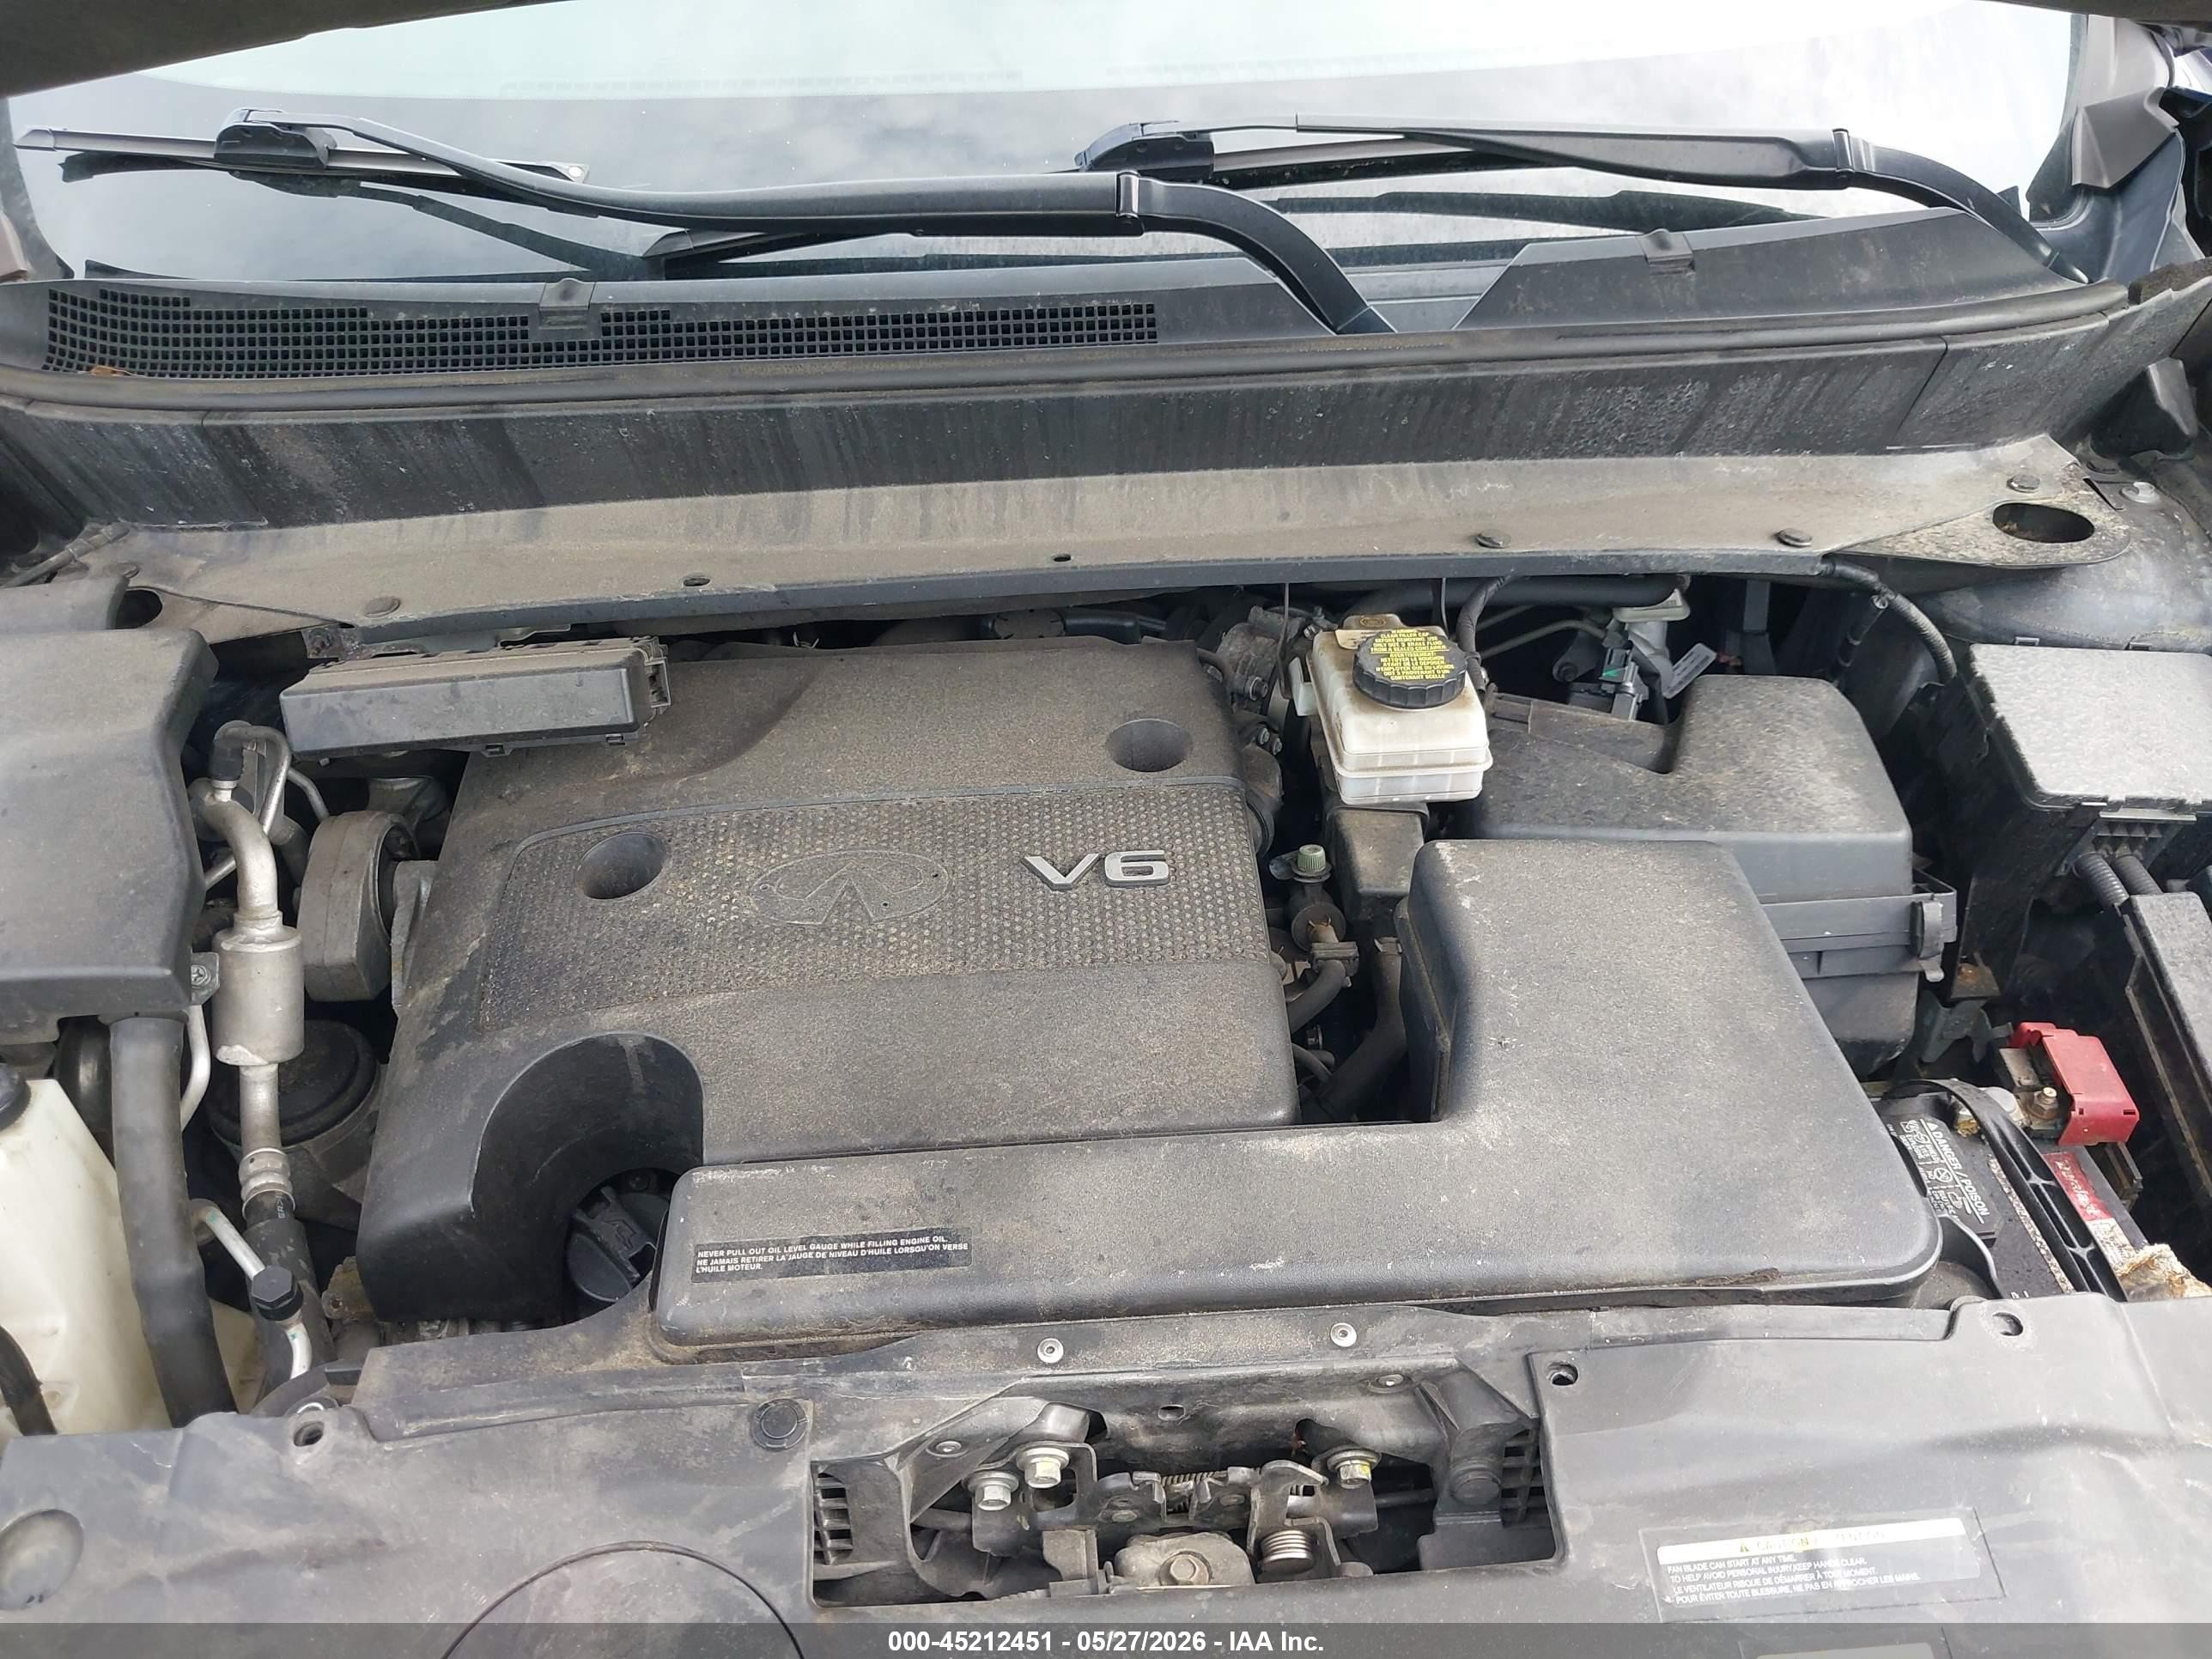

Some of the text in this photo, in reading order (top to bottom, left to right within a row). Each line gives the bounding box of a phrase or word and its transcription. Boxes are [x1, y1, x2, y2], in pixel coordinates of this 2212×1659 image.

[1021, 849, 1170, 891] V6
[1932, 1132, 1963, 1170] DANGER
[1960, 1178, 1990, 1217] POISON
[741, 1255, 774, 1264] RETIRER
[829, 1249, 858, 1258] NIVEAU
[894, 1244, 939, 1255] LORSQU'ON
[943, 1243, 969, 1251] VERSE
[841, 1241, 865, 1249] WHILE
[867, 1239, 897, 1248] FILLING
[696, 1264, 725, 1273] L'HUILE
[1668, 1565, 1682, 1573] FAN
[1685, 1563, 1707, 1571] BLADE
[1709, 1561, 1725, 1570] CAN
[1727, 1559, 1749, 1568] START
[1751, 1558, 1759, 1566] AT
[1762, 1556, 1777, 1565] ANY
[1670, 1574, 1680, 1583] TO
[1681, 1572, 1702, 1582] HELP
[1703, 1571, 1726, 1579] AVOID
[1727, 1567, 1767, 1578] PERSONAL
[1673, 1586, 1684, 1595] LE
[1684, 1582, 1731, 1594] VENTILATEUR
[1733, 1578, 1761, 1589] RISQUE
[1762, 1577, 1773, 1586] DE
[1816, 1570, 1822, 1579] À
[1676, 1594, 1698, 1604] POUR
[1699, 1590, 1725, 1602] ÉVITER
[1726, 1589, 1749, 1598] TOUTE
[1793, 1584, 1805, 1593] NE
[1806, 1582, 1820, 1591] PAS
[1822, 1581, 1834, 1589] EN
[1880, 1575, 1893, 1583] LES
